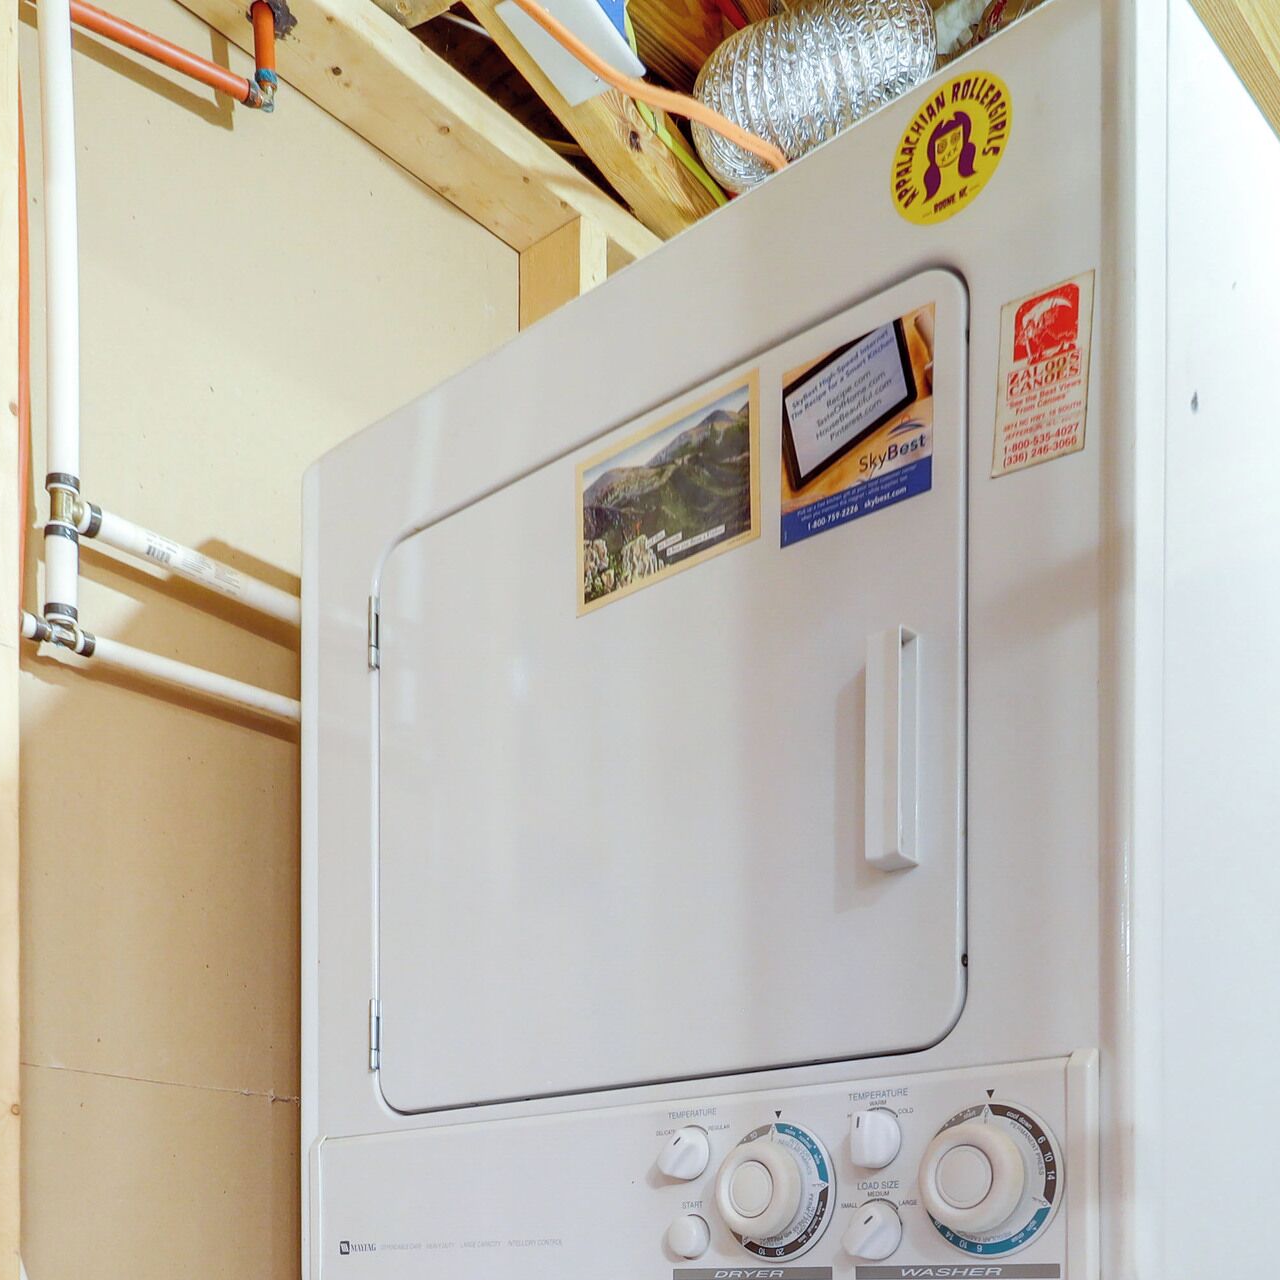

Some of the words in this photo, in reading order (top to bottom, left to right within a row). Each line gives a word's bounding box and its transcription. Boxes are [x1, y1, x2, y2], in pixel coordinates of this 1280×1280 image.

[896, 92, 945, 208] APPALACHIAN
[951, 77, 1007, 156] ROLLERGIRLS
[1009, 365, 1078, 396] CANOES
[859, 434, 926, 472] SkyBest
[864, 486, 906, 508] skybest.com
[848, 1088, 908, 1101] TEMPERATURE
[668, 1108, 717, 1120] TEMPERATURE
[1006, 1110, 1019, 1122] cool
[1018, 1116, 1033, 1131] down
[1037, 1135, 1046, 1144] 6
[1043, 1151, 1054, 1162] 10
[1047, 1171, 1056, 1181] 14
[857, 1182, 879, 1190] LOAD
[881, 1181, 899, 1190] SIZE
[682, 1201, 703, 1209] START
[351, 1241, 377, 1253] MAYTAG
[714, 1269, 784, 1278] DRYER
[901, 1266, 1002, 1278] WASHER
